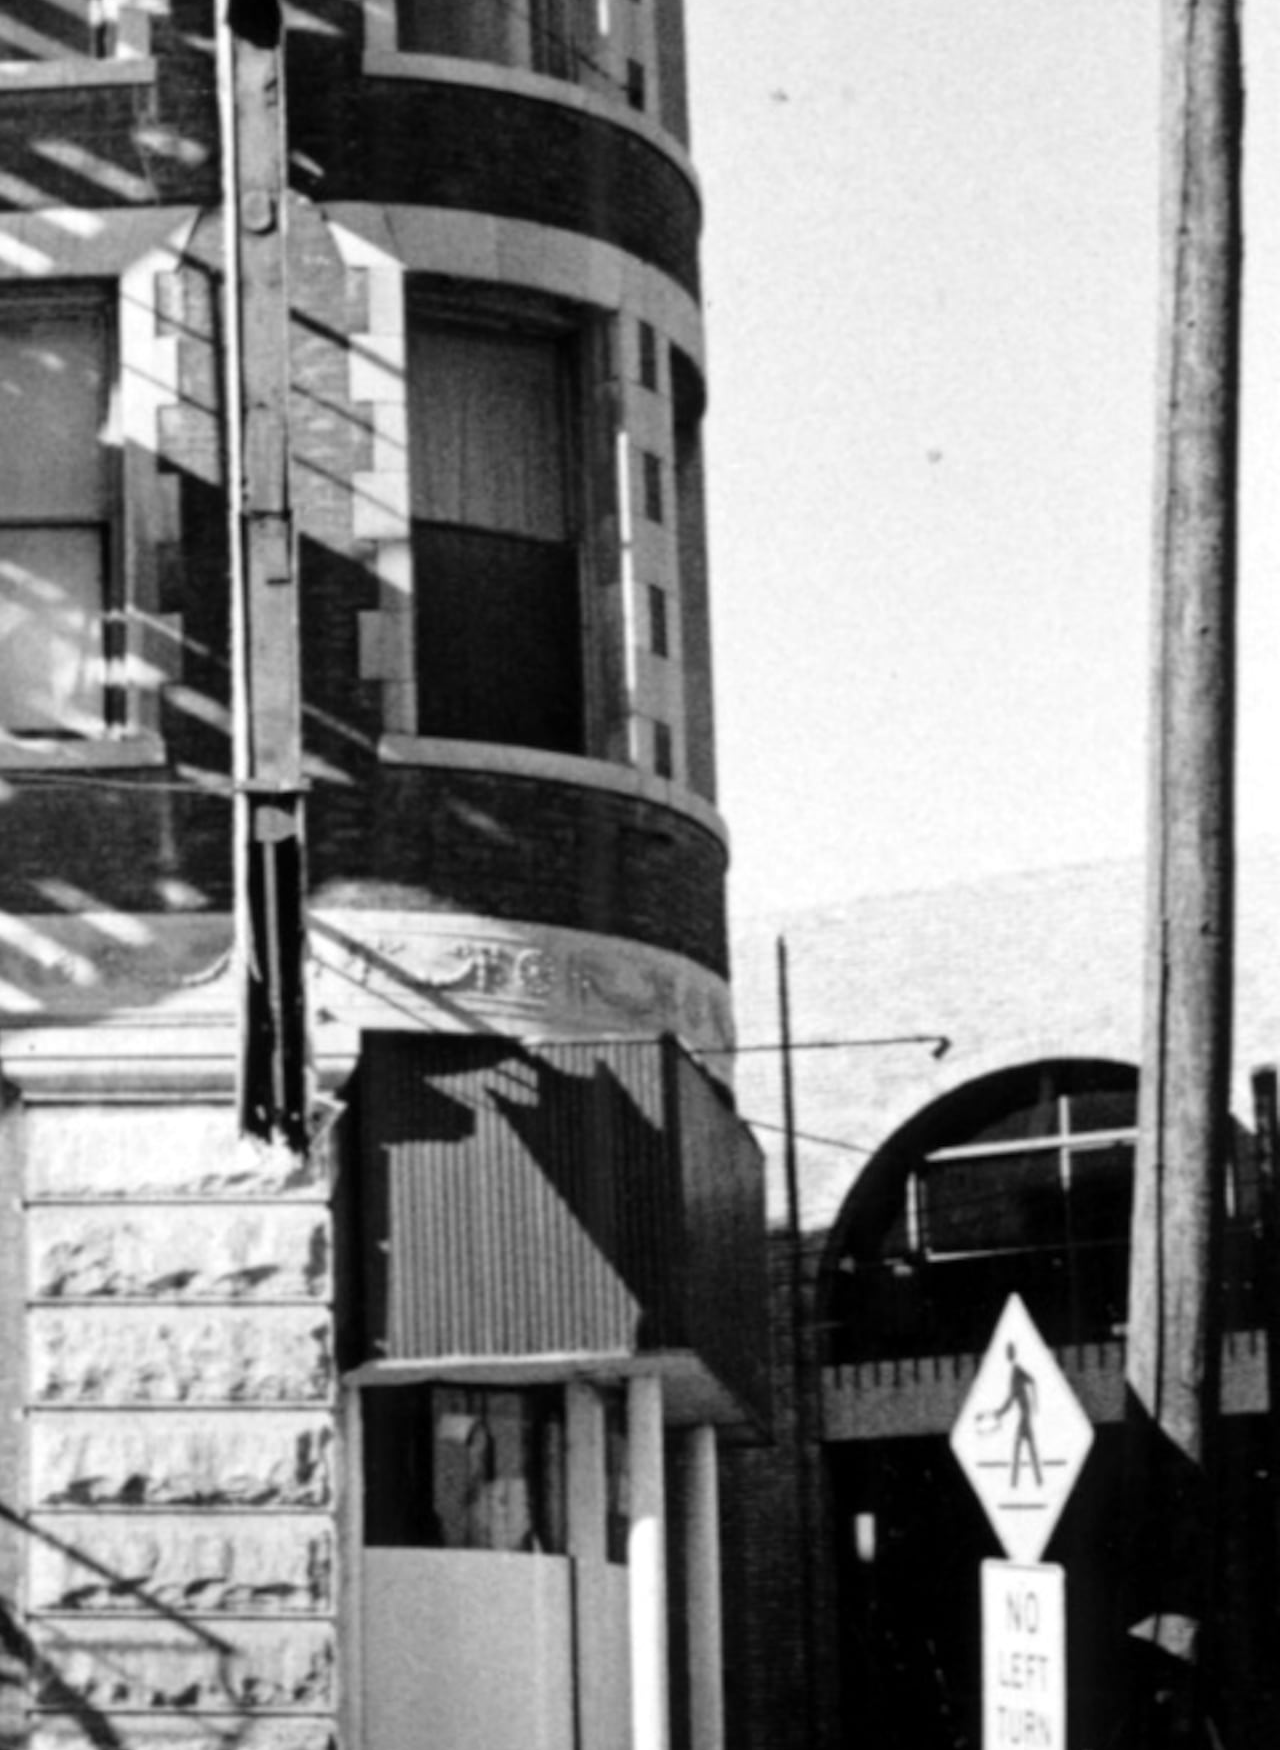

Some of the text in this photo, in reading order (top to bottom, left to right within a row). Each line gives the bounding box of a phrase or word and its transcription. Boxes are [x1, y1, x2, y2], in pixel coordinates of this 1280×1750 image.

[1004, 1588, 1040, 1635] NO
[997, 1650, 1050, 1691] LEFT
[996, 1704, 1053, 1748] TURN
